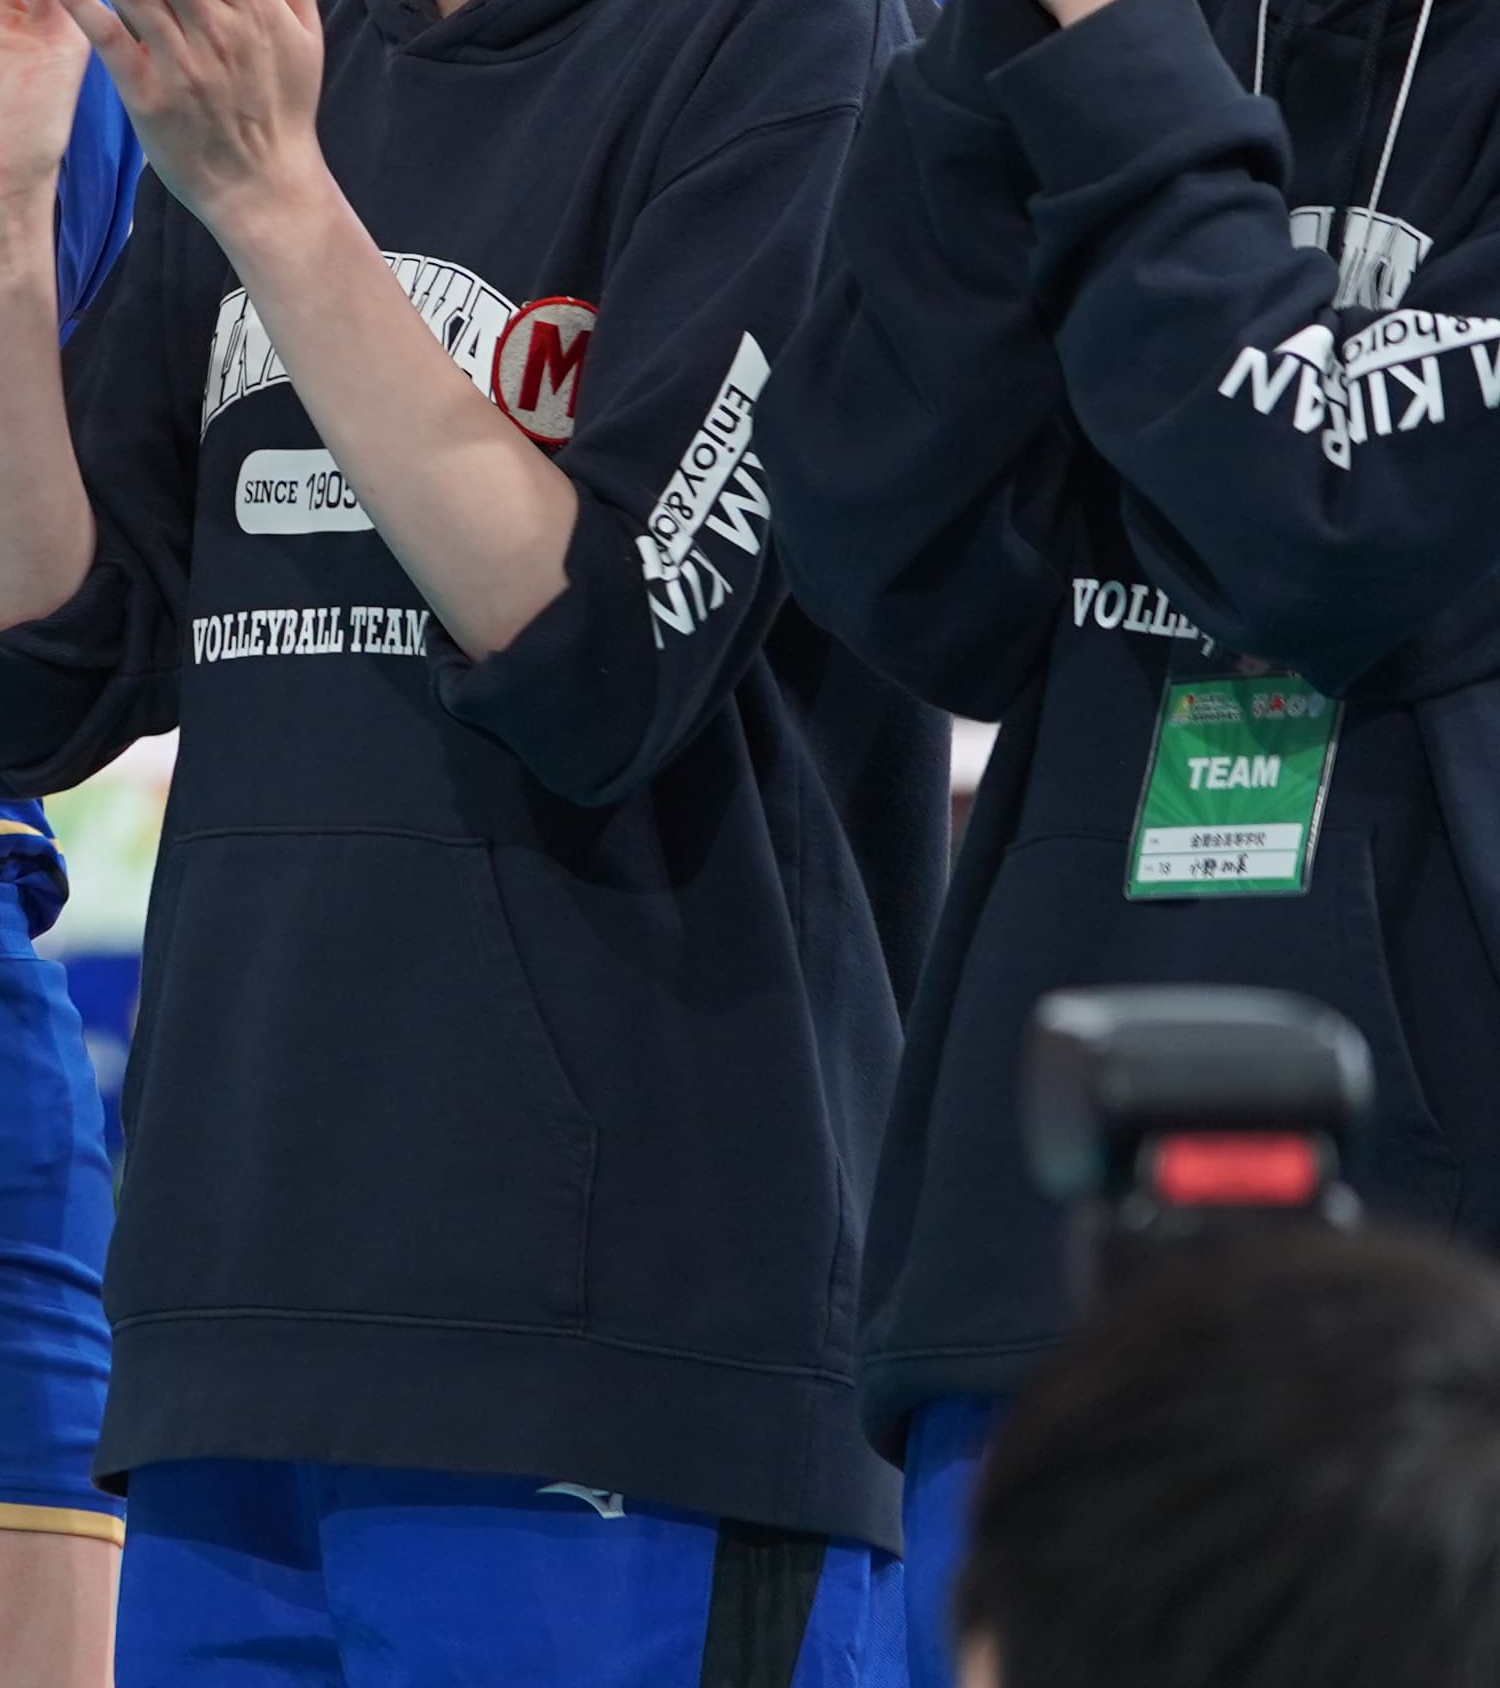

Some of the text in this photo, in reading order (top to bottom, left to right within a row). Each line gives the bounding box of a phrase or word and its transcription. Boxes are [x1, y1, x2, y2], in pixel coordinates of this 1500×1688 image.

[517, 320, 591, 419] M
[243, 480, 299, 505] SINCE
[192, 606, 431, 665] VOLLEYBALL TEAM
[1187, 754, 1281, 791] TEAM
